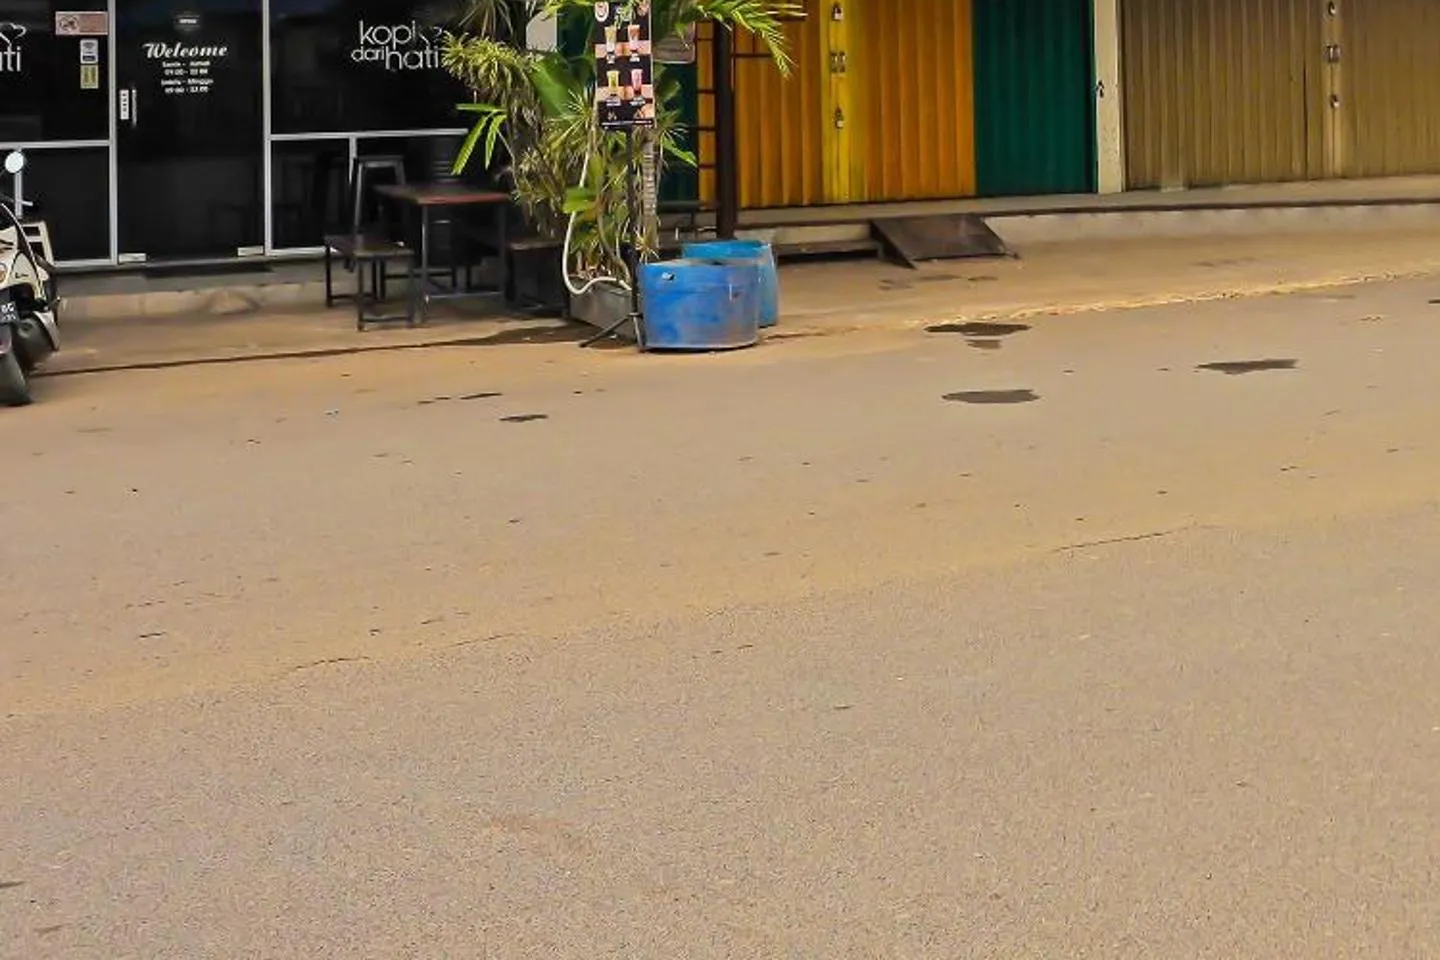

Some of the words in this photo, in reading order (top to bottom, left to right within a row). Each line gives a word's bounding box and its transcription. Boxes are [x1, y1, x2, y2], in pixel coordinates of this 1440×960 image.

[359, 20, 415, 50] kopi
[142, 42, 228, 58] Welcome
[350, 45, 384, 62] dari
[385, 44, 439, 70] hati
